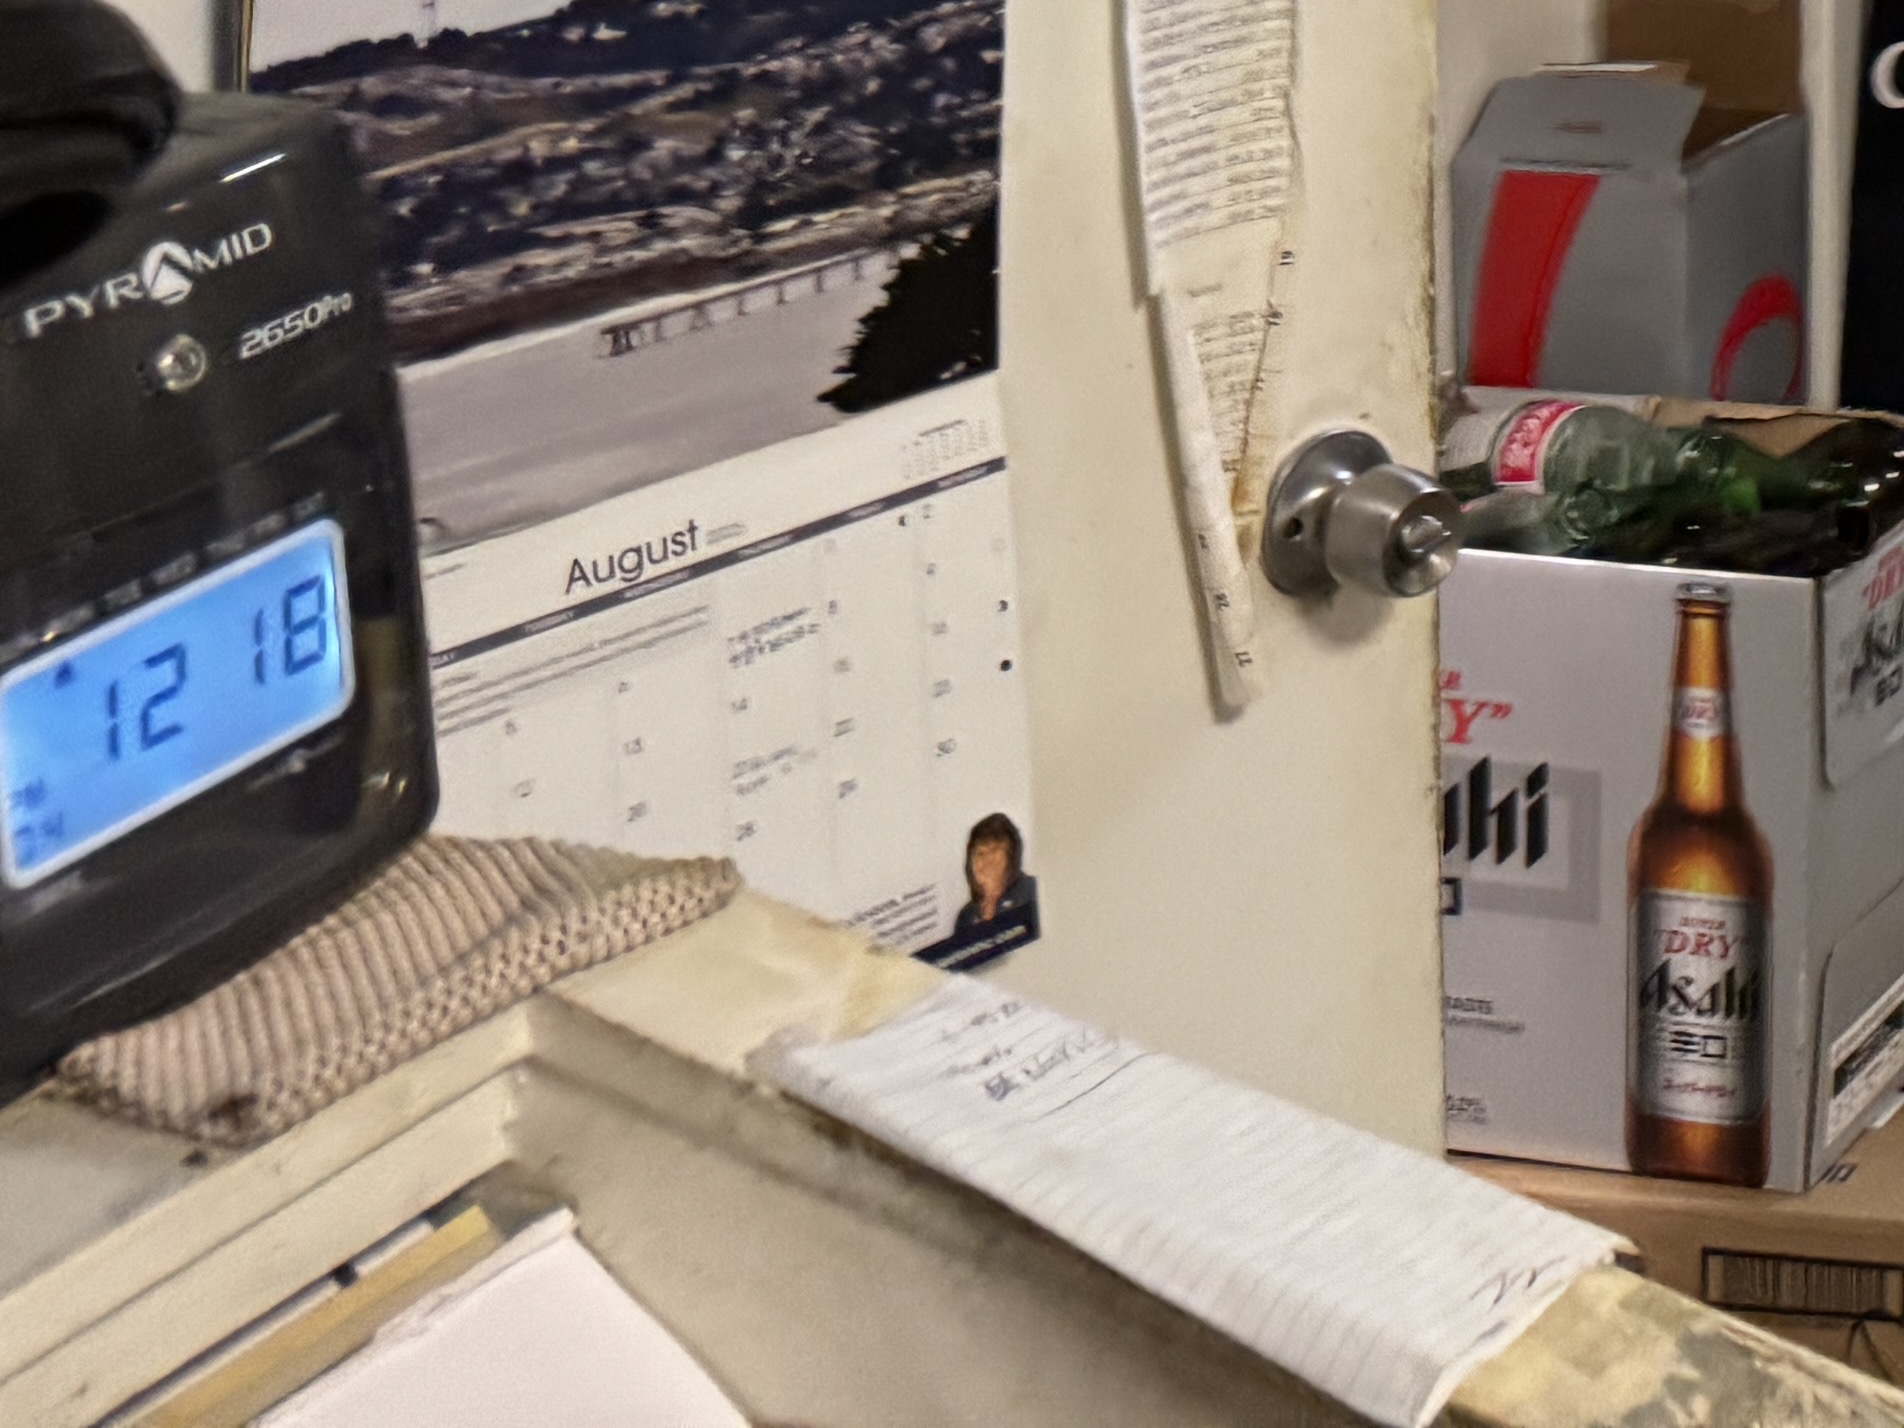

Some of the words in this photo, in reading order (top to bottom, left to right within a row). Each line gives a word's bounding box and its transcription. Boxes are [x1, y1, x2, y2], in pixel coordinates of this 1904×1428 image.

[23, 223, 273, 338] PYRAMID
[564, 519, 698, 593] August
[107, 643, 187, 761] 12
[253, 574, 327, 686] 18
